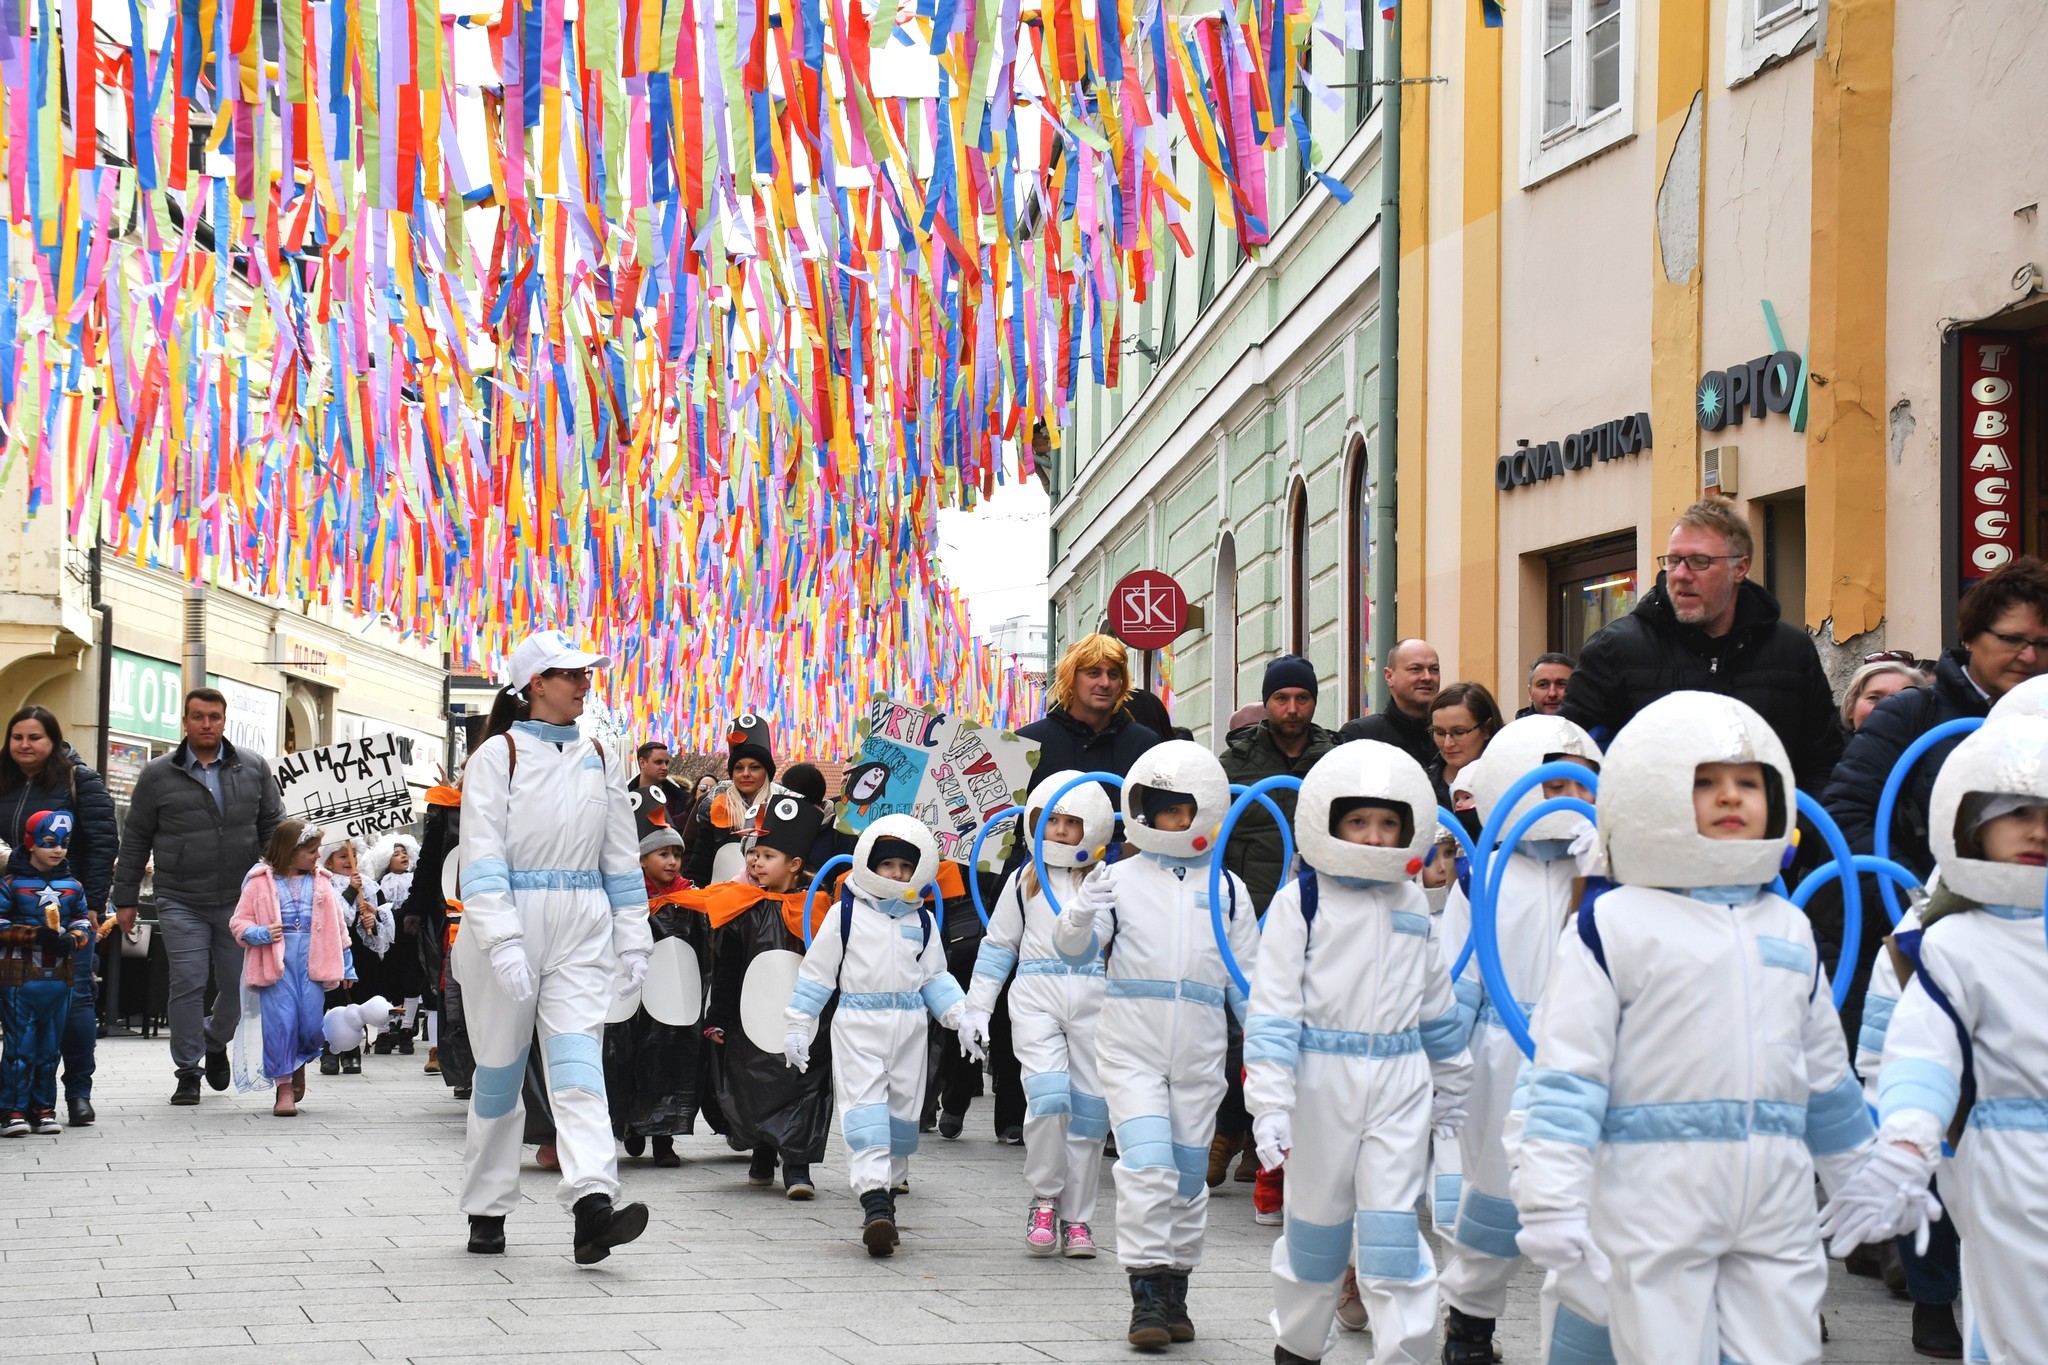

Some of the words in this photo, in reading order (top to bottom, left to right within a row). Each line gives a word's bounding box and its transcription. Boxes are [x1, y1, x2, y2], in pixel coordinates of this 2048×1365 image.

[1496, 439, 1564, 490] OČNA
[1563, 412, 1652, 470] OPTIKA
[1970, 344, 2013, 572] TOBACCO
[229, 719, 266, 755] LOGOS
[49, 814, 72, 833] A
[347, 807, 414, 837] CVRČAK
[931, 764, 977, 837] SKUPINA
